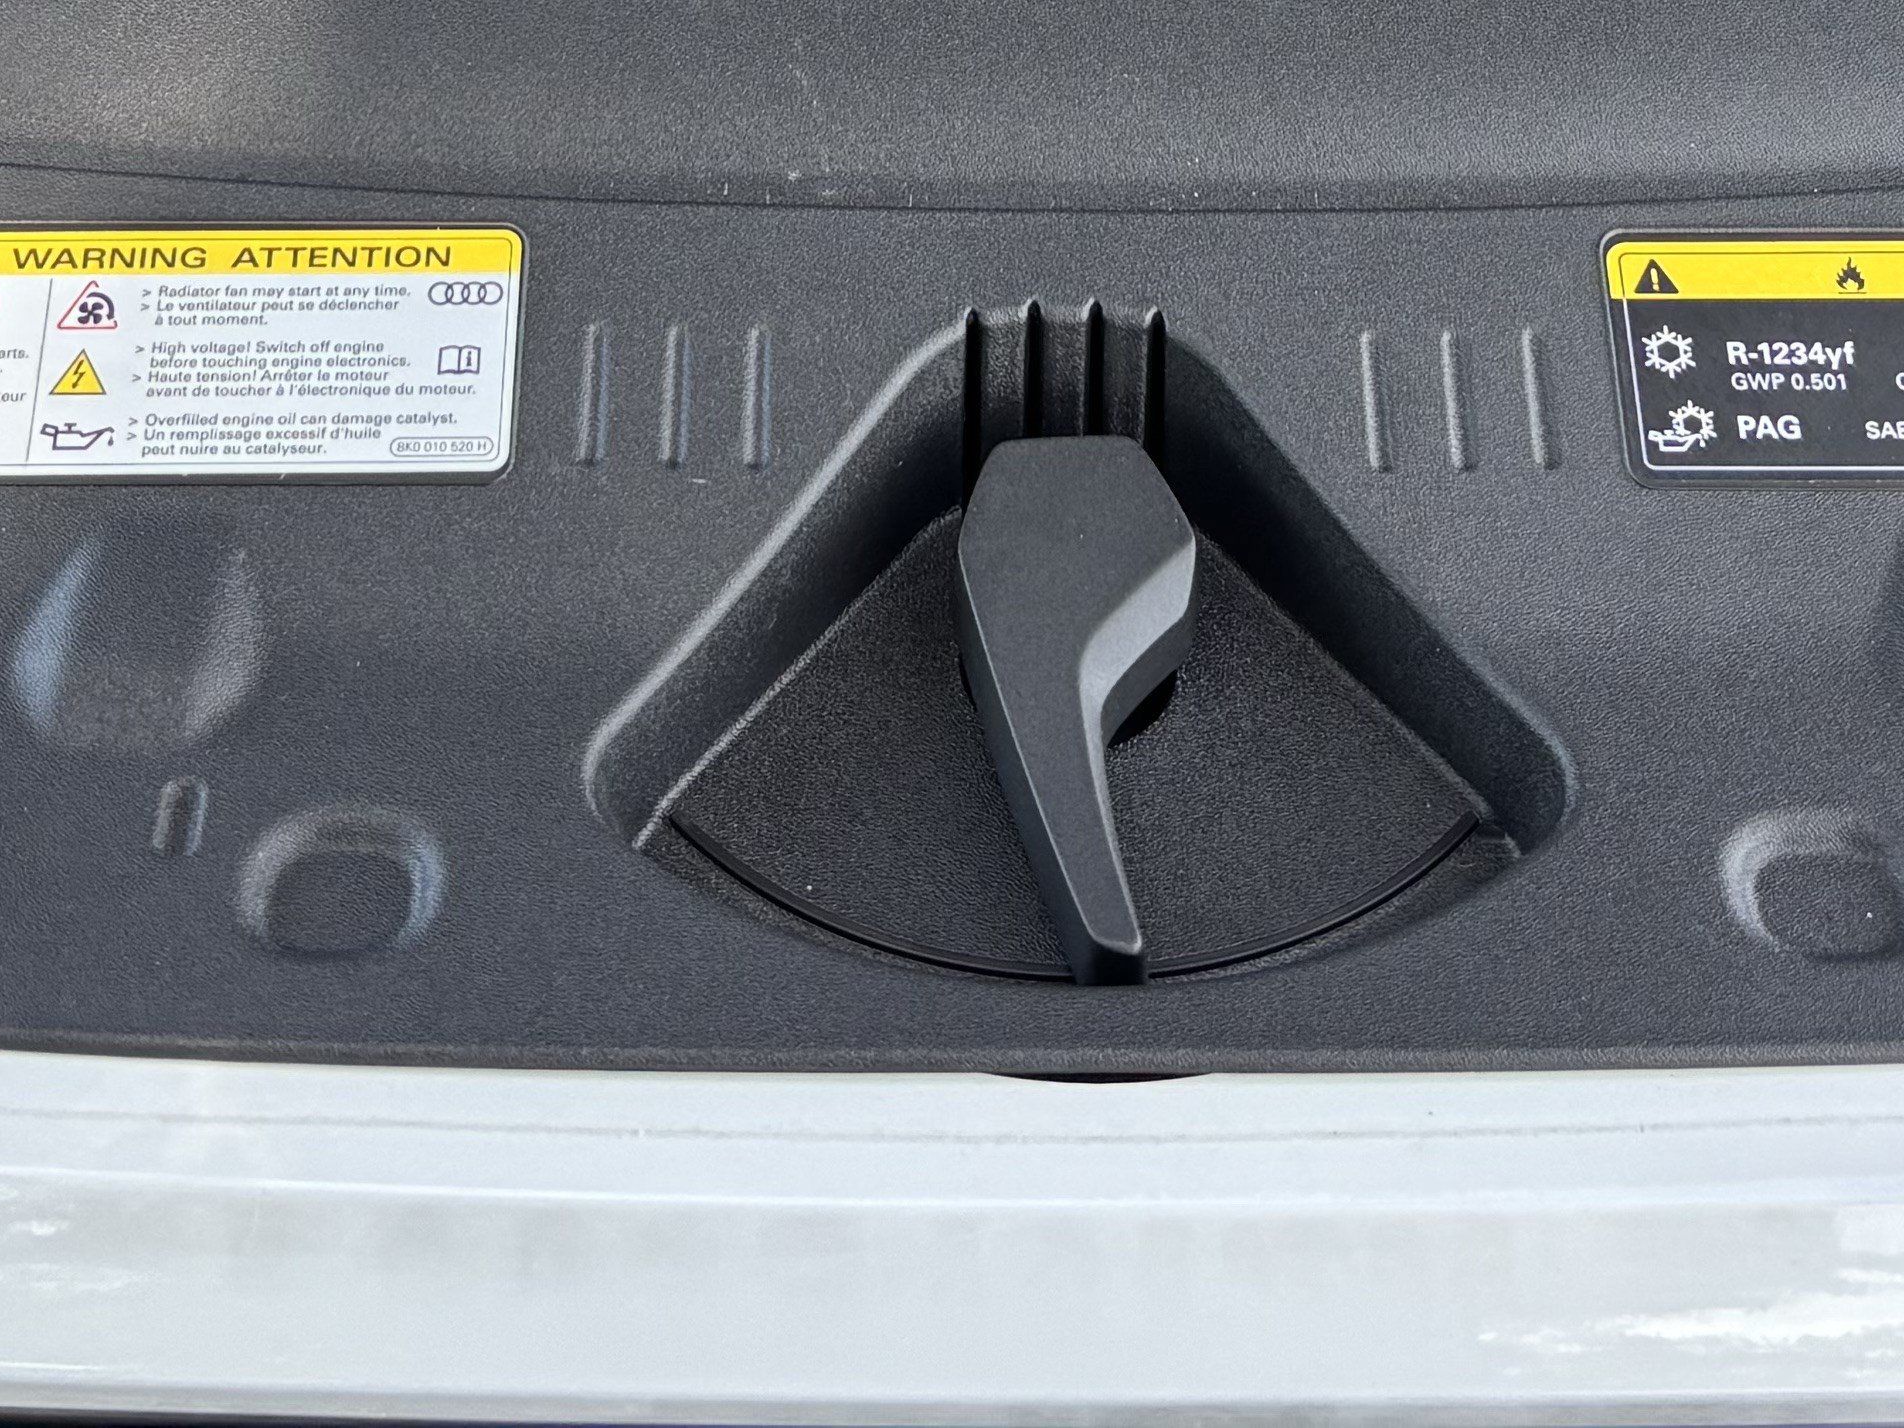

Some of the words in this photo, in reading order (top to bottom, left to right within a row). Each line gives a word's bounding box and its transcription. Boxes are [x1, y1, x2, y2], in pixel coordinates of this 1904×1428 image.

[12, 247, 206, 271] WARNING
[231, 246, 452, 269] ATTENTION
[158, 285, 221, 297] Radiator
[225, 285, 247, 297] fan
[252, 287, 284, 298] may
[288, 287, 322, 297] start
[326, 287, 338, 297] at
[343, 287, 370, 298] any
[375, 286, 411, 297] time.
[157, 300, 174, 311] Le
[179, 300, 257, 311] ventilateur
[261, 301, 294, 313] peut
[298, 300, 314, 311] se
[168, 315, 197, 326] tout
[201, 315, 268, 325] moment.
[151, 342, 186, 355] High
[191, 341, 251, 355] voltage!
[256, 341, 305, 353] Switch
[310, 340, 331, 352] off
[334, 340, 385, 354] engine
[1727, 341, 1855, 368] R-1234yf
[150, 356, 197, 368] before
[202, 356, 267, 369] touching
[272, 356, 322, 367] engine
[326, 355, 411, 367] electronics.
[148, 370, 192, 383] Haute
[197, 370, 257, 382] tension!
[318, 369, 330, 381] le
[335, 371, 390, 380] moteur
[1731, 373, 1786, 391] GWP
[1792, 373, 1847, 391] 0.501
[146, 386, 188, 397] avant
[192, 385, 210, 397] de
[215, 385, 272, 397] toucher
[395, 383, 413, 395] du
[419, 384, 476, 395] moteur.
[145, 413, 218, 427] Overfilled
[222, 414, 273, 428] engine
[278, 413, 296, 425] oil
[301, 414, 327, 425] can
[331, 413, 392, 427] damage
[396, 411, 457, 426] catalyst.
[1737, 416, 1801, 439] PAG
[143, 429, 165, 441] Un
[170, 428, 262, 443] remplissage
[265, 427, 327, 439] excessif
[330, 427, 381, 439] d'huile
[141, 444, 175, 457] peut
[180, 443, 218, 455] nuire
[223, 444, 241, 454] au
[246, 443, 326, 456] catalyseur.
